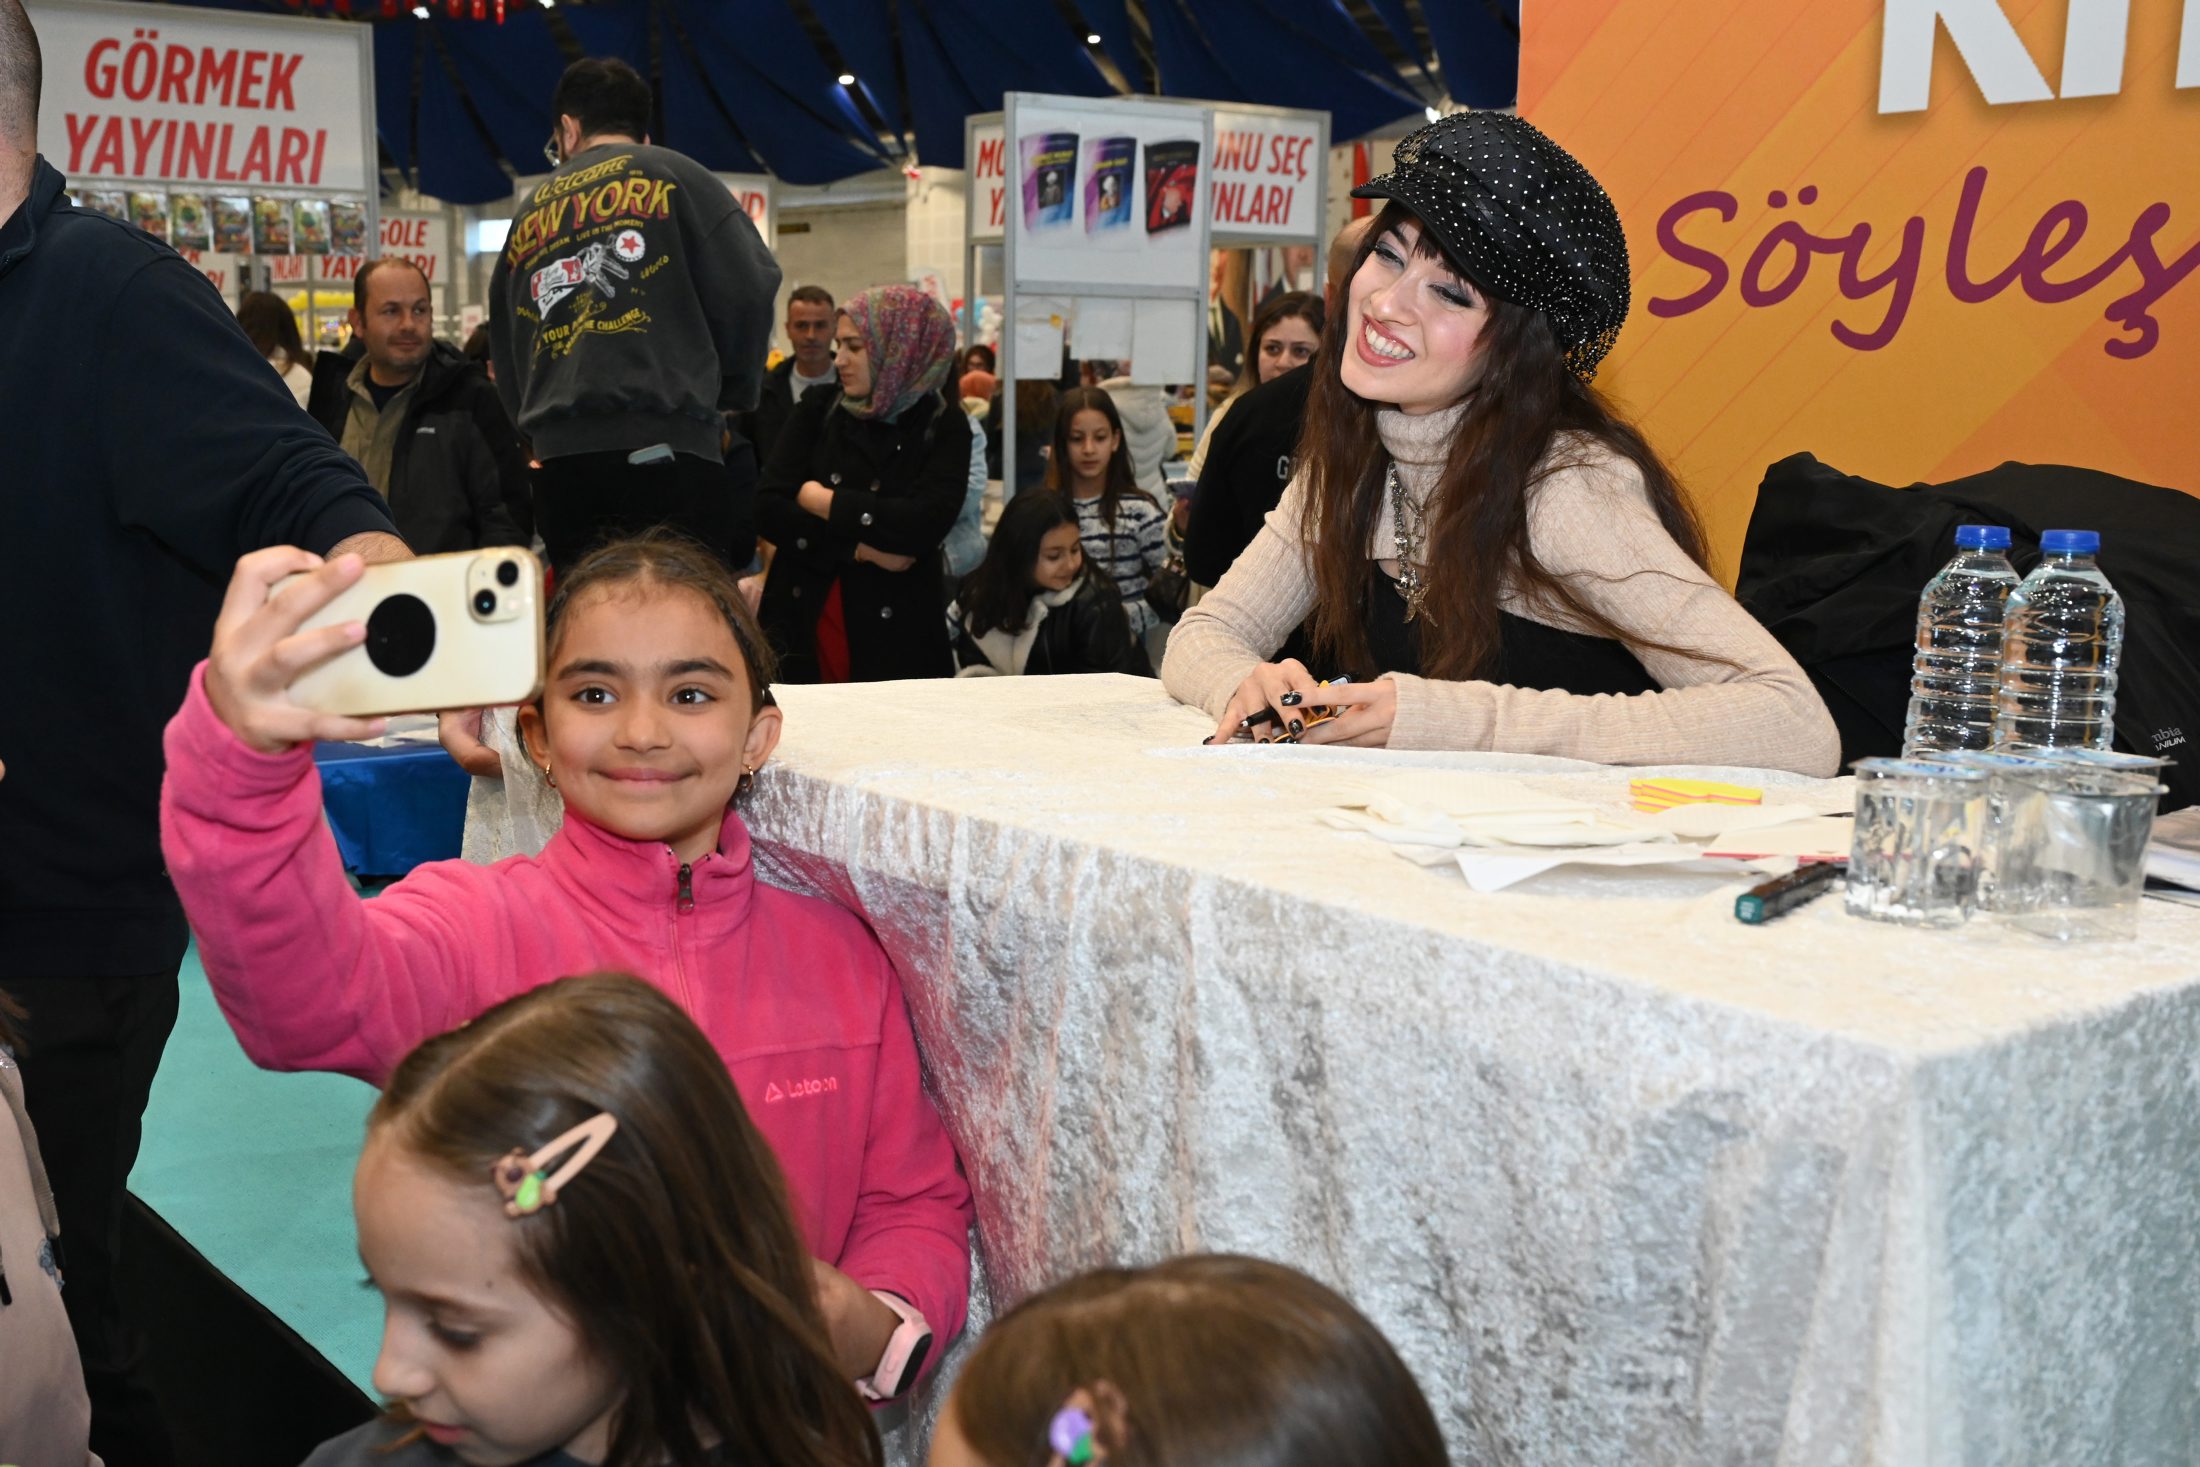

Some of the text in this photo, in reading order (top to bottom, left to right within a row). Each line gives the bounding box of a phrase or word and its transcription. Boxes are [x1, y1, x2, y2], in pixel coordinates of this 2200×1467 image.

[84, 28, 304, 111] GÖRMEK
[65, 113, 328, 185] YAYINLARI
[1267, 134, 1313, 182] SEÇ
[507, 177, 677, 268] NEW YORK
[543, 325, 570, 343] YOUR
[597, 307, 641, 331] CHALLENGE
